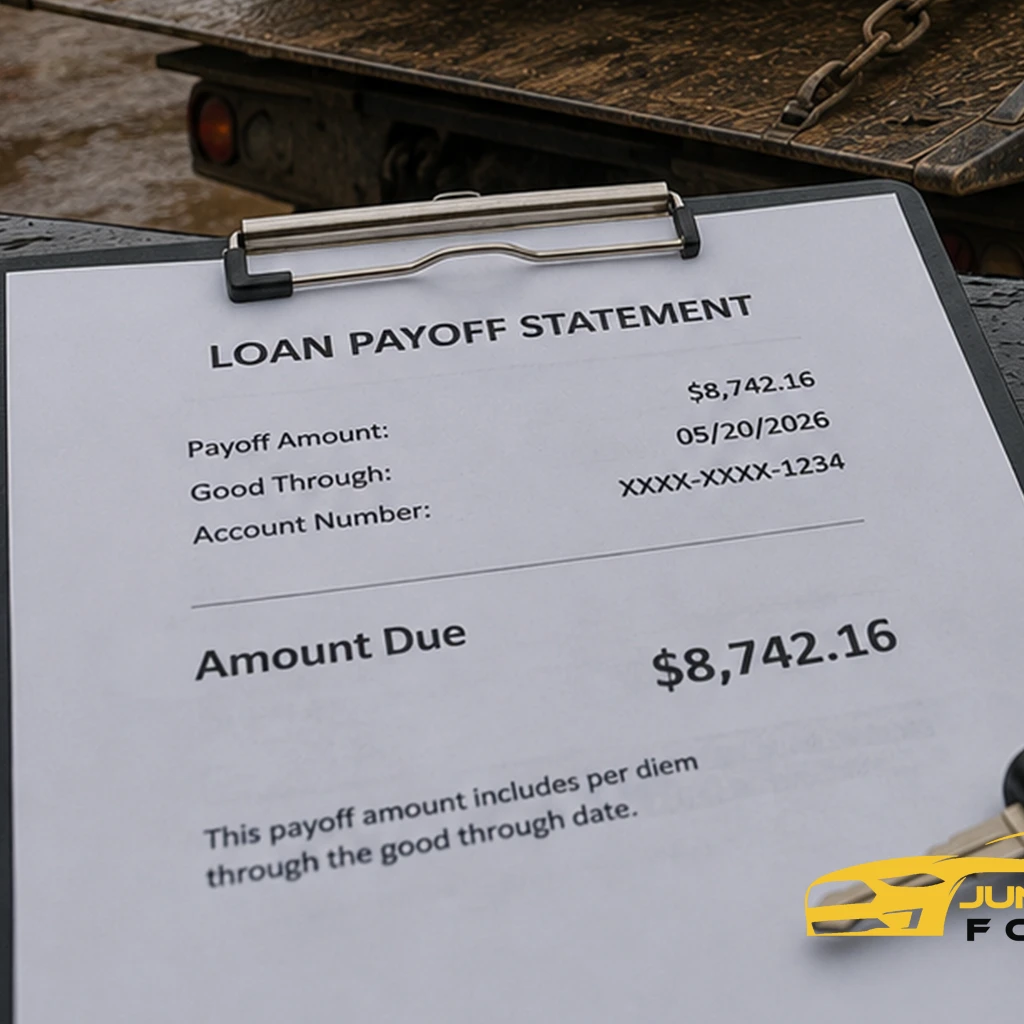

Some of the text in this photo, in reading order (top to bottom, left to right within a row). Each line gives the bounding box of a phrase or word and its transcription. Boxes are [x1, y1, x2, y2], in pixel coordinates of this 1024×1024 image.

[211, 295, 751, 368] LOAN PAYOFF STATEMENT
[688, 371, 815, 403] $8,742.16
[188, 424, 388, 459] Payoff Amount:
[677, 411, 829, 445] 05/20/2026
[191, 466, 391, 501] Good Through:
[619, 453, 845, 497] XXXX-XXXX-1234
[193, 505, 430, 544] Account Number:
[196, 626, 465, 681] Amount Due
[653, 619, 896, 692] $8,742.16
[204, 756, 698, 849] This payoff amount includes per diem
[206, 803, 637, 888] through the good through date.
